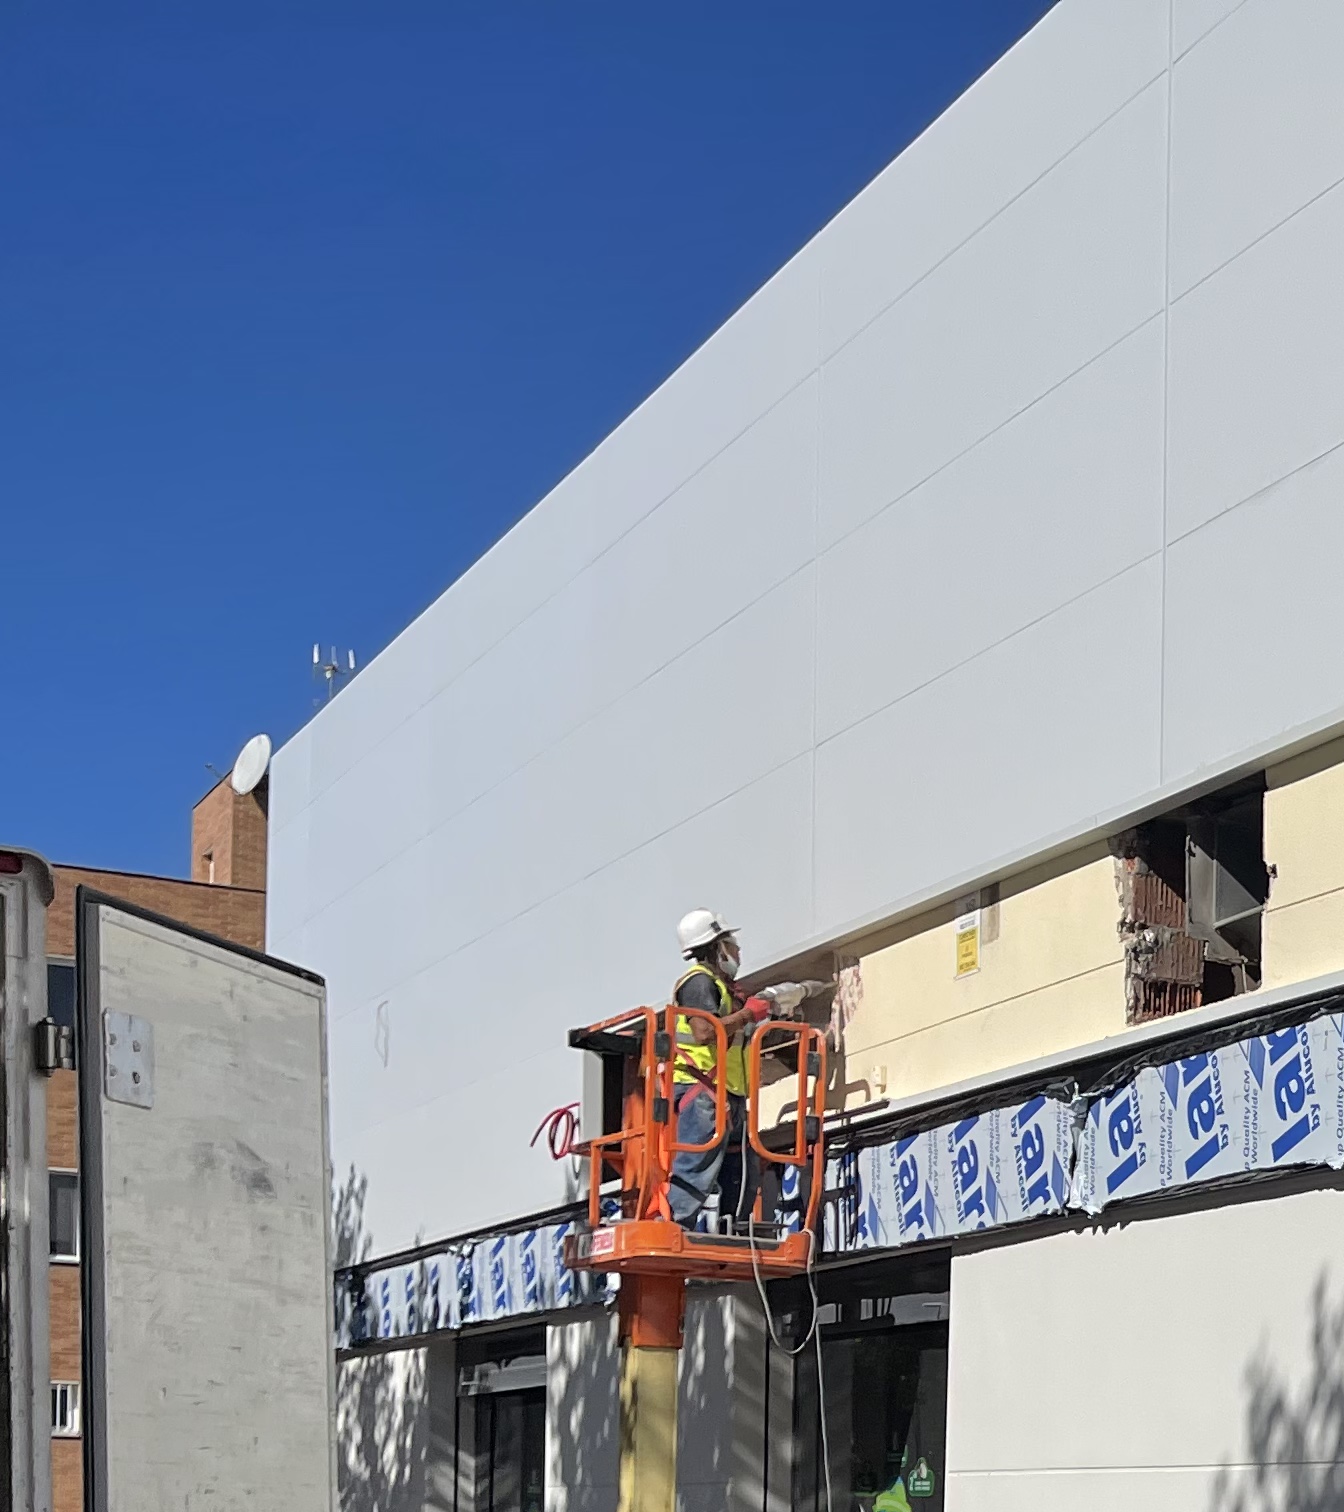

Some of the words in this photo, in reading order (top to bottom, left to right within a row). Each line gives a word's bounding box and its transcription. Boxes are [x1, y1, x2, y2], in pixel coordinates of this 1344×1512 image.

[1336, 1047, 1344, 1081] ACM
[1242, 1107, 1250, 1158] Quality
[1336, 1085, 1344, 1139] Quality
